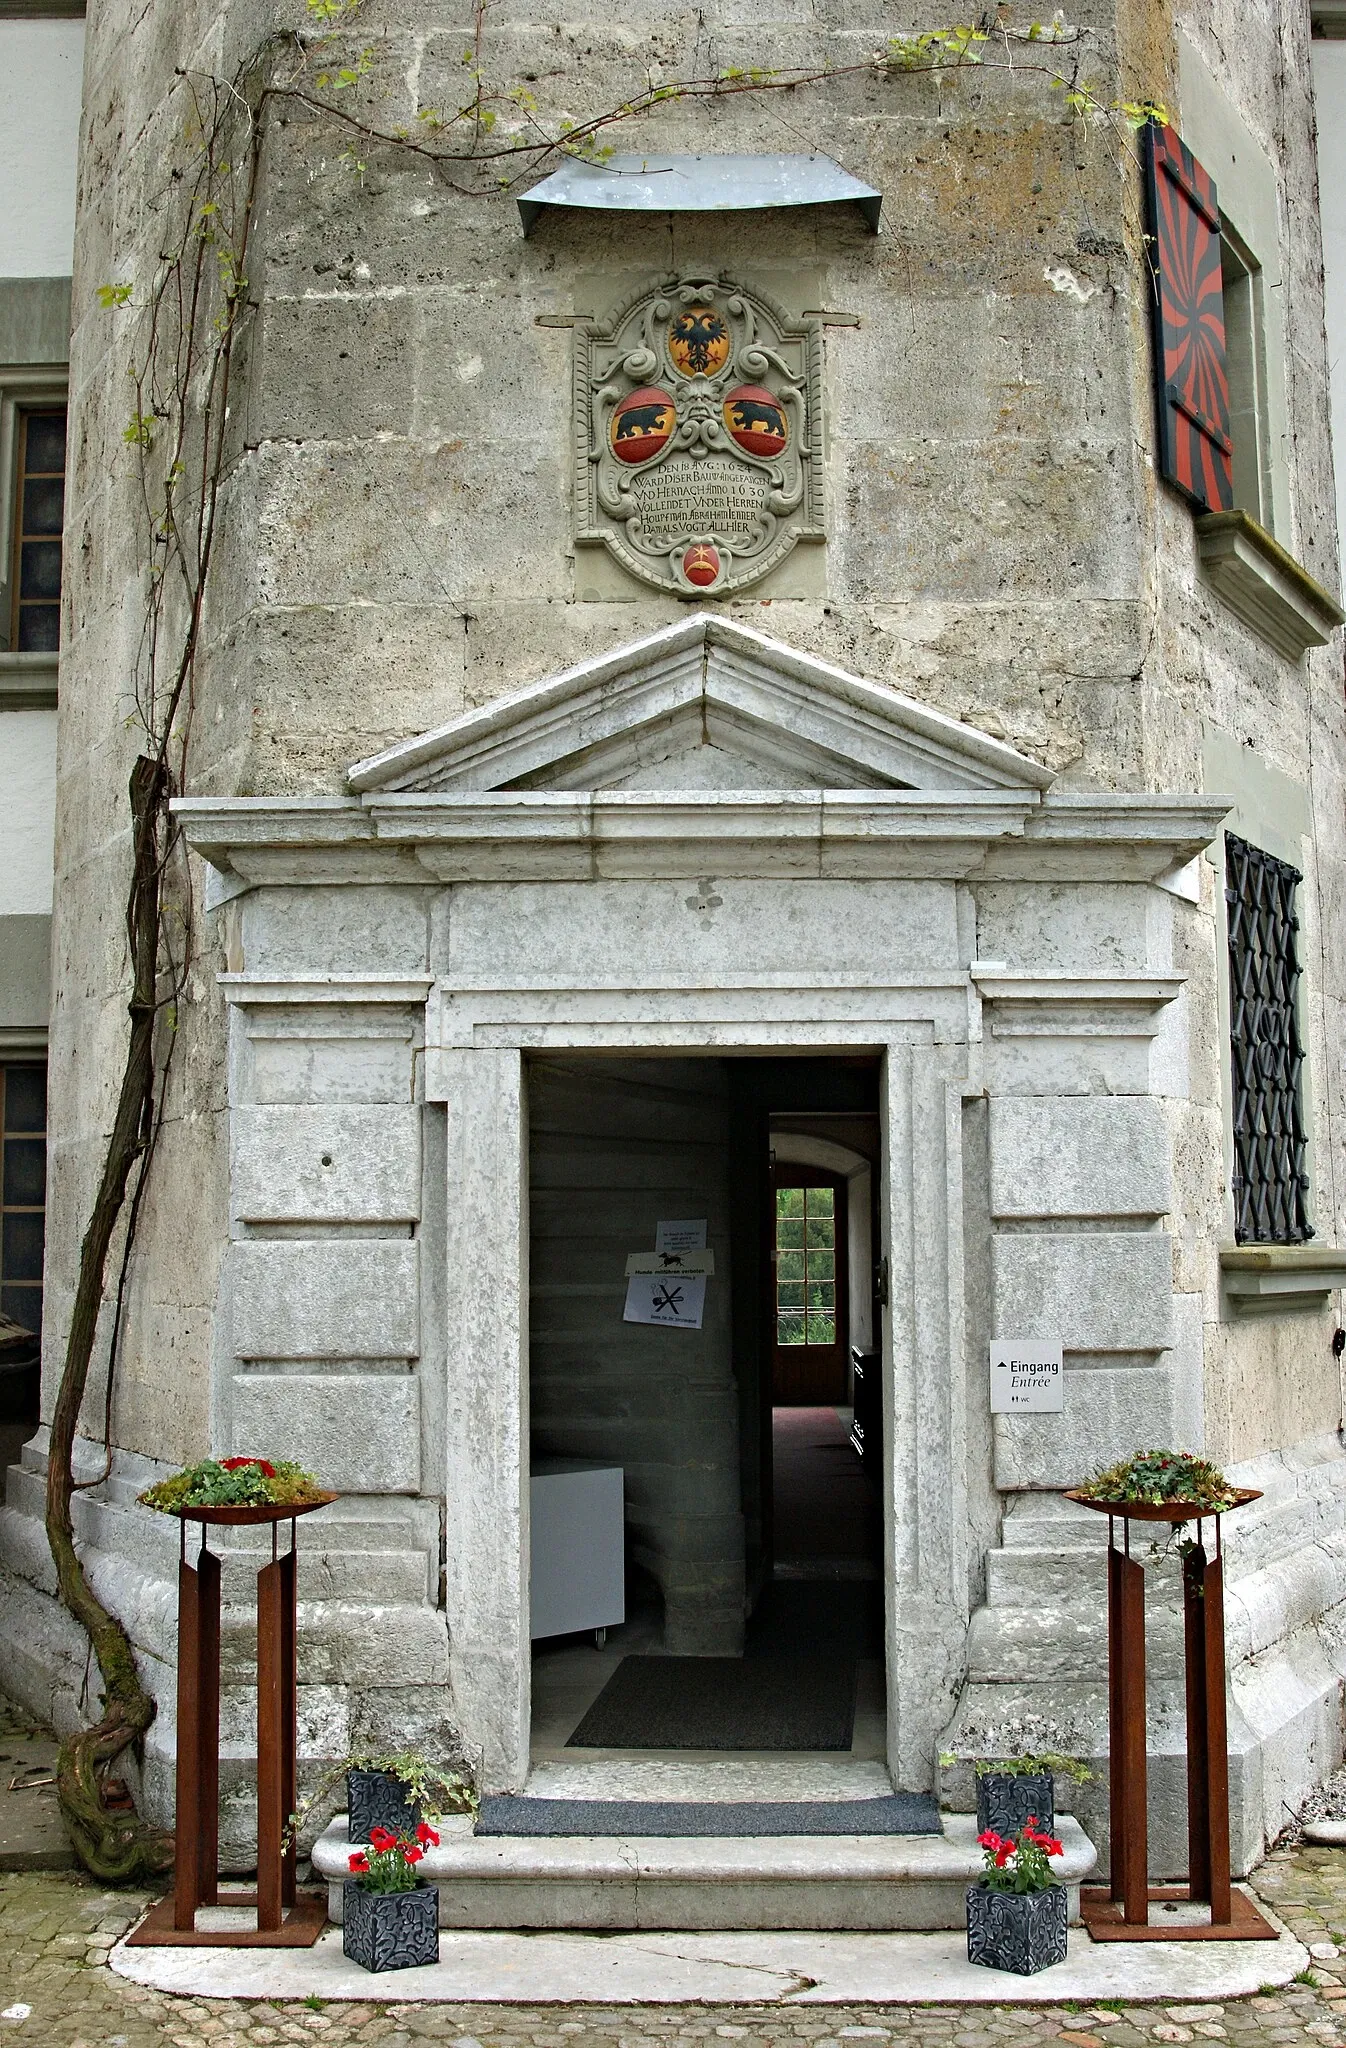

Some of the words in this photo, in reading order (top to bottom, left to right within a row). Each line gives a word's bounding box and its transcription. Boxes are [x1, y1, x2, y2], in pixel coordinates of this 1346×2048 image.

[658, 464, 679, 474] DEN
[722, 461, 752, 473] 1624
[634, 477, 664, 488] WARD
[731, 484, 765, 498] 1630
[636, 498, 692, 513] VOLLENDET
[726, 497, 763, 510] HERREN
[643, 523, 679, 535] DAMALS
[678, 521, 707, 533] VOGT
[1010, 1360, 1059, 1375] Eingang
[1011, 1375, 1051, 1388] Entrée
